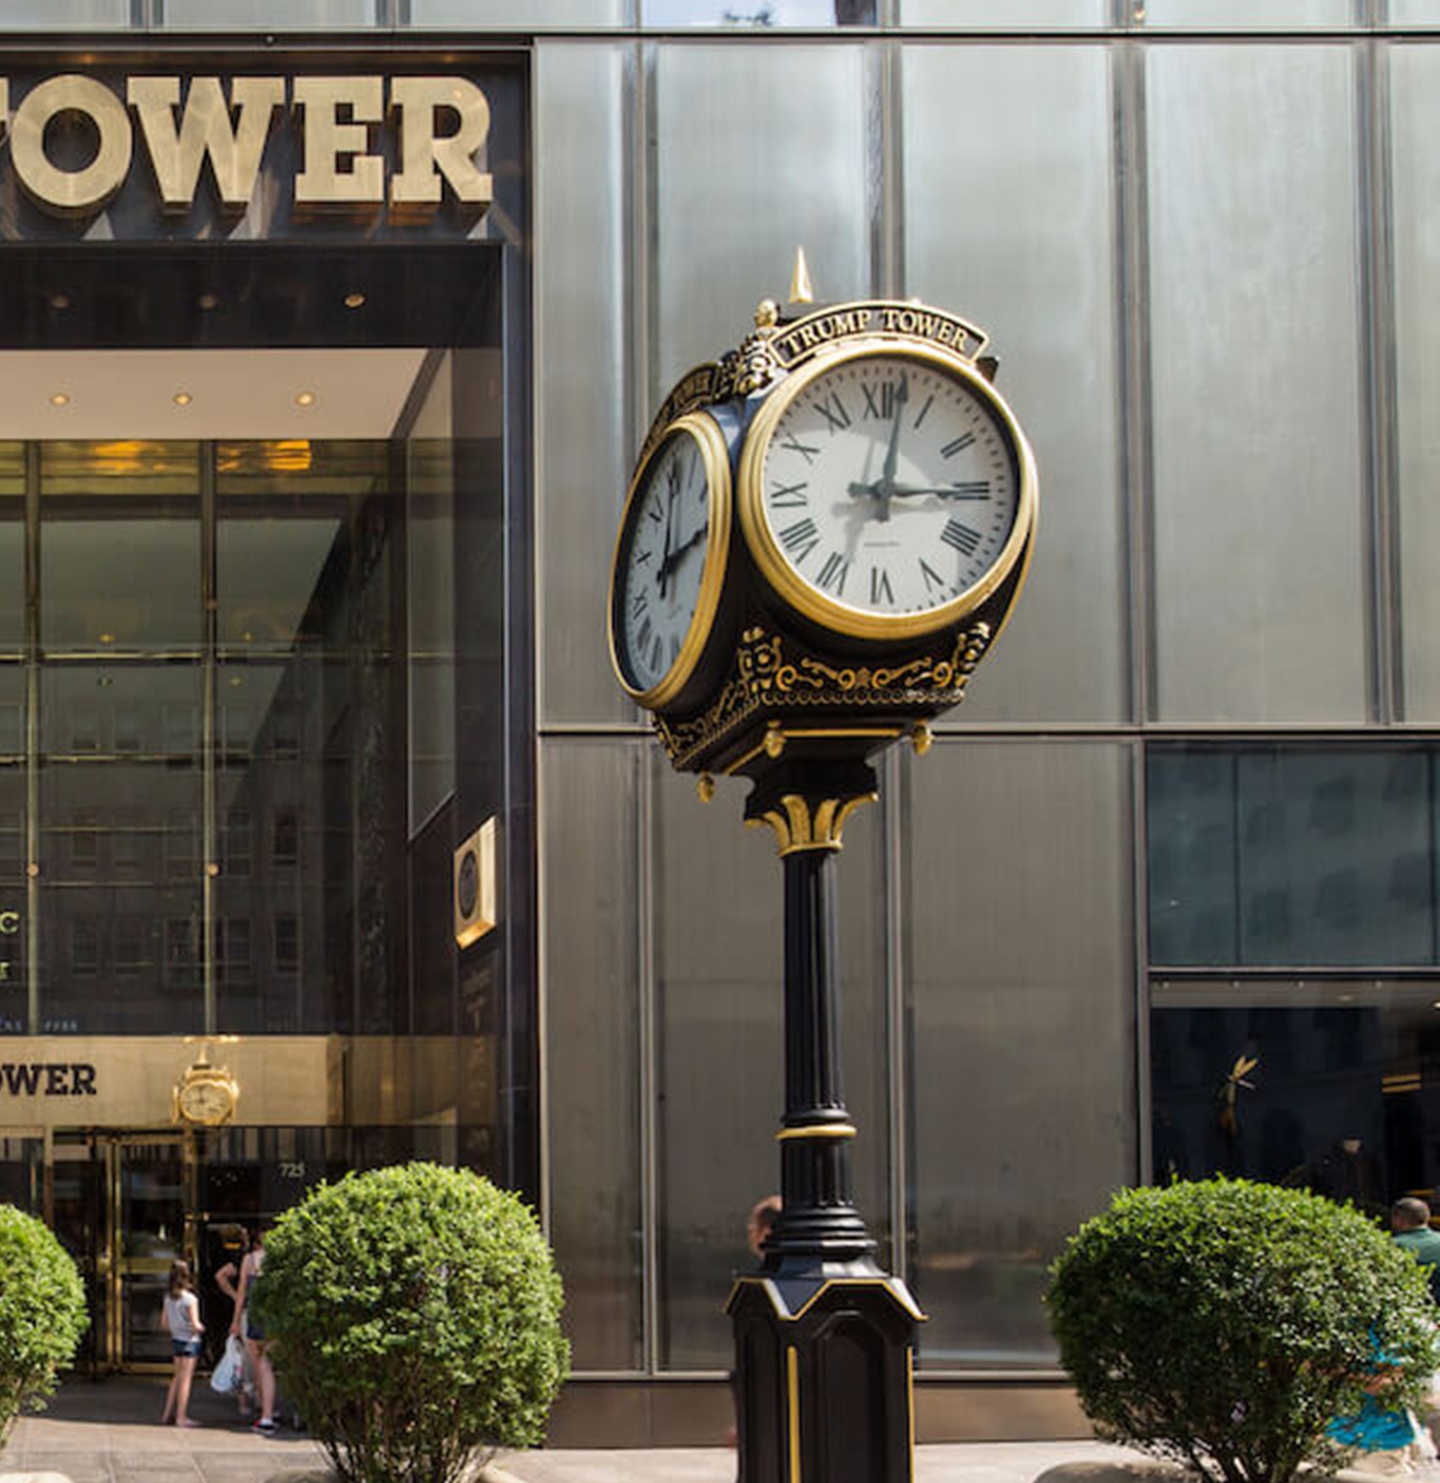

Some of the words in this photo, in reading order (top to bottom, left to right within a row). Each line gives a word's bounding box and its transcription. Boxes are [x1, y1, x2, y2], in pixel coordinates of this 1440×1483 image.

[782, 309, 872, 354] TRUMP
[882, 309, 970, 352] TOWER
[862, 381, 895, 420] XII
[279, 1161, 306, 1178] 725
